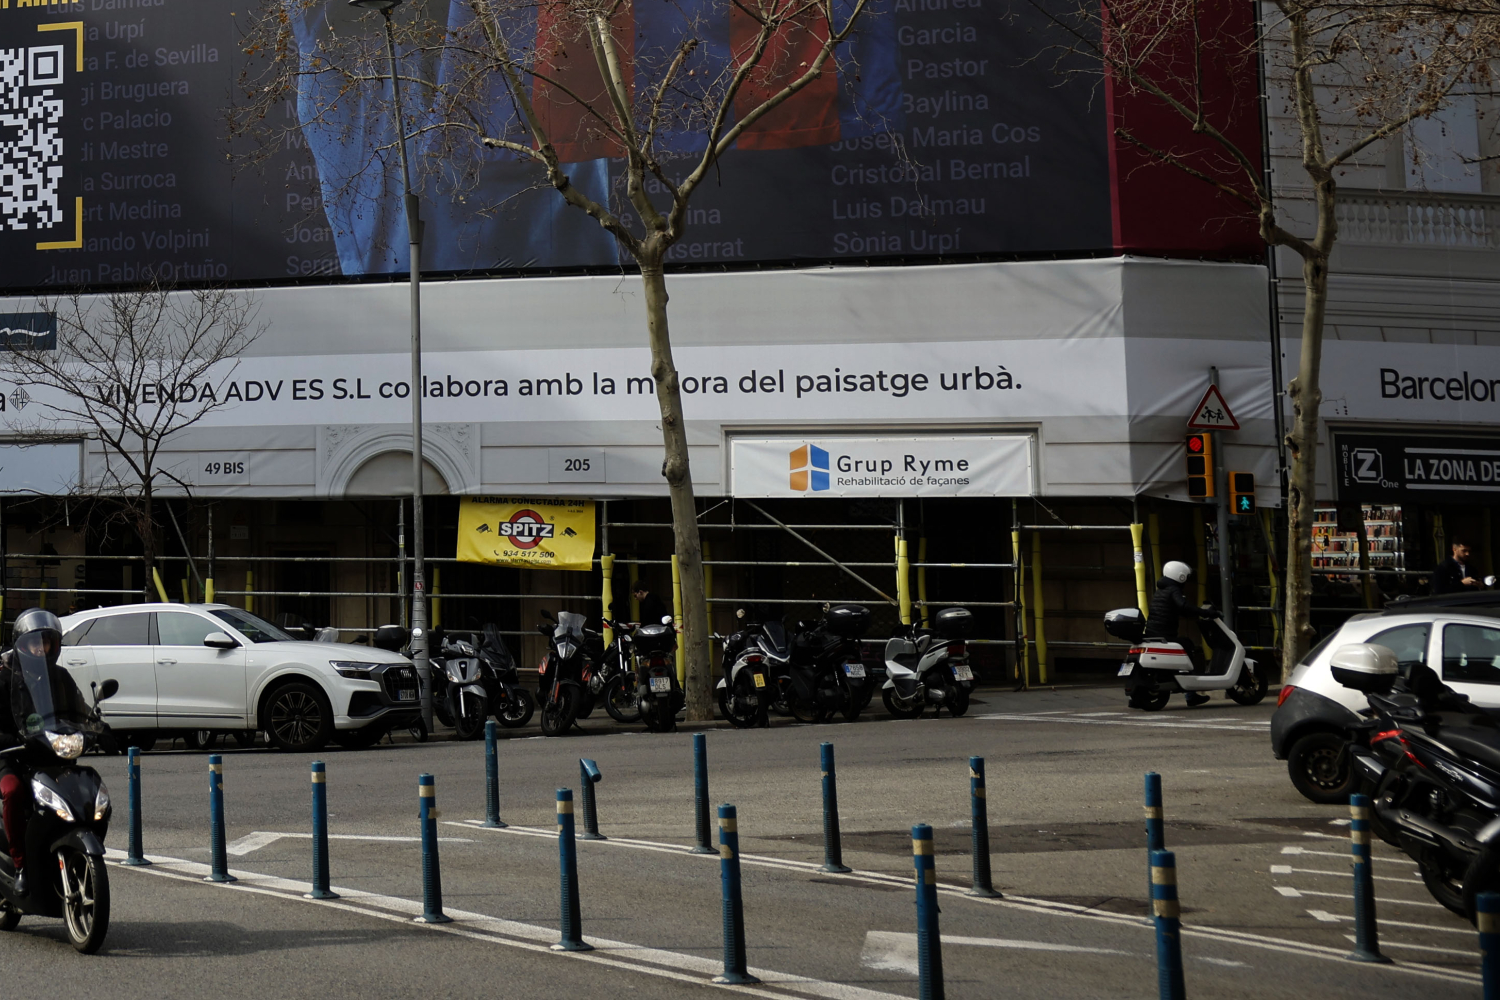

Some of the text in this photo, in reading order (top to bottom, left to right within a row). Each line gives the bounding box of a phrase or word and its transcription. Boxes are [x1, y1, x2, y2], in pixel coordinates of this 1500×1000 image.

[831, 157, 1030, 186] Cristóbal Bernal
[833, 193, 985, 219] Luis Dalmau
[833, 228, 960, 253] Sònia Urpí
[96, 382, 217, 404] VIVENDA
[224, 379, 283, 402] ADV
[292, 379, 324, 400] ES
[332, 378, 371, 399] S.L
[378, 374, 508, 398] colabora
[518, 372, 583, 396] amb
[593, 372, 616, 395] la
[738, 369, 785, 393] del
[796, 367, 929, 399] paisatge
[940, 366, 1022, 391] urbà.
[205, 462, 244, 474] 49 BIS
[564, 459, 590, 472] 205
[837, 455, 969, 476] Grup Ryme
[1341, 444, 1350, 487] MOBILE
[1357, 453, 1399, 489] Z One
[1404, 458, 1426, 479] LA
[1429, 459, 1477, 481] ZONA
[837, 476, 970, 487] Rehabilitació de façanes
[471, 496, 509, 504] ALARMA
[511, 498, 565, 506] CONECTADA
[501, 523, 553, 537] SPITZ
[521, 550, 537, 558] 517
